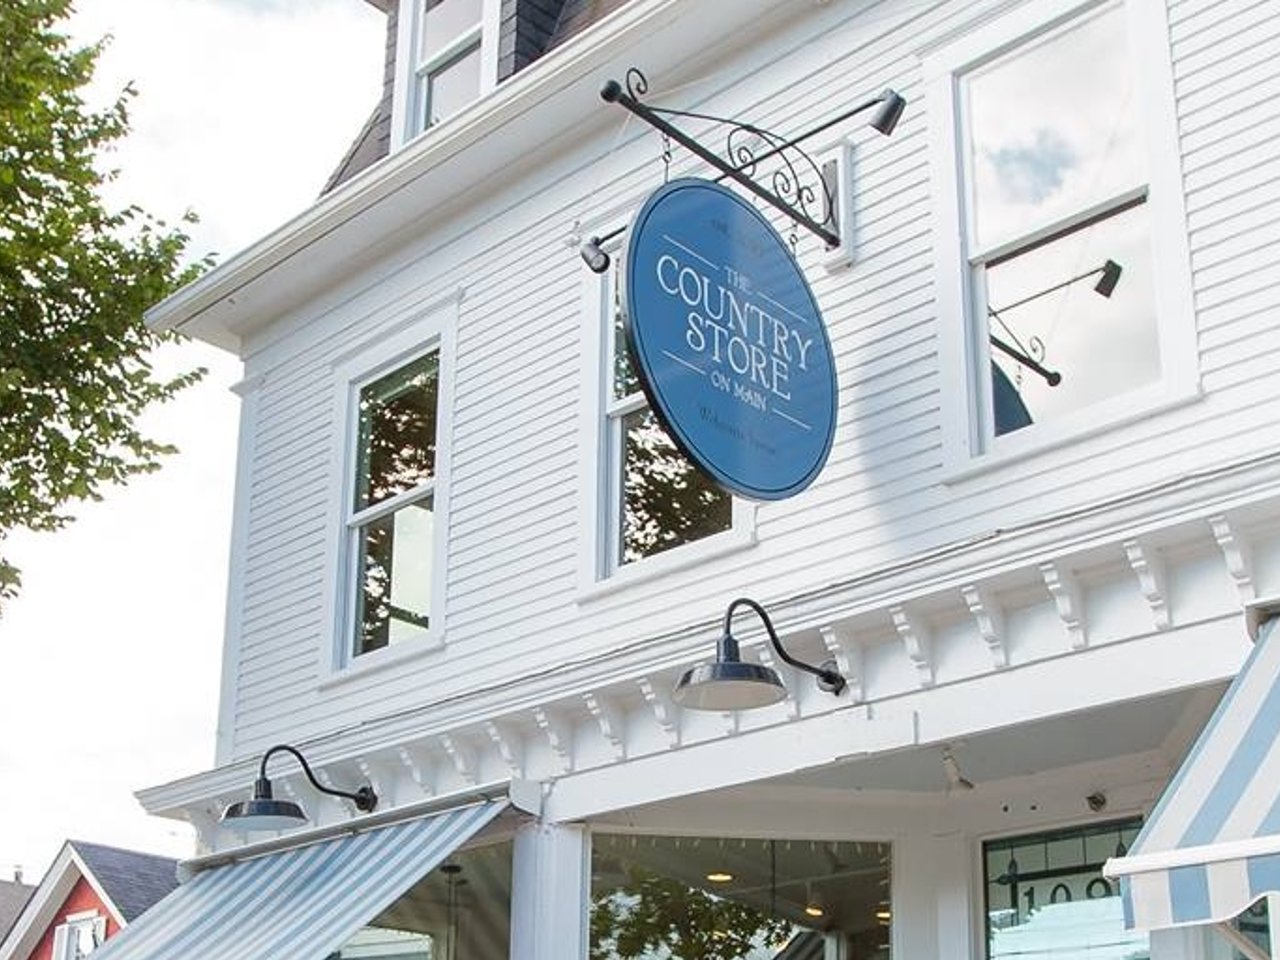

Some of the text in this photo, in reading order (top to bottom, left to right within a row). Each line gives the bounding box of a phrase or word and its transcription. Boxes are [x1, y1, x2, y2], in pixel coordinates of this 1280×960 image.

[724, 265, 754, 294] THE
[656, 254, 814, 371] COUNTRY
[685, 311, 792, 401] STORE
[710, 370, 767, 411] ON MAIN
